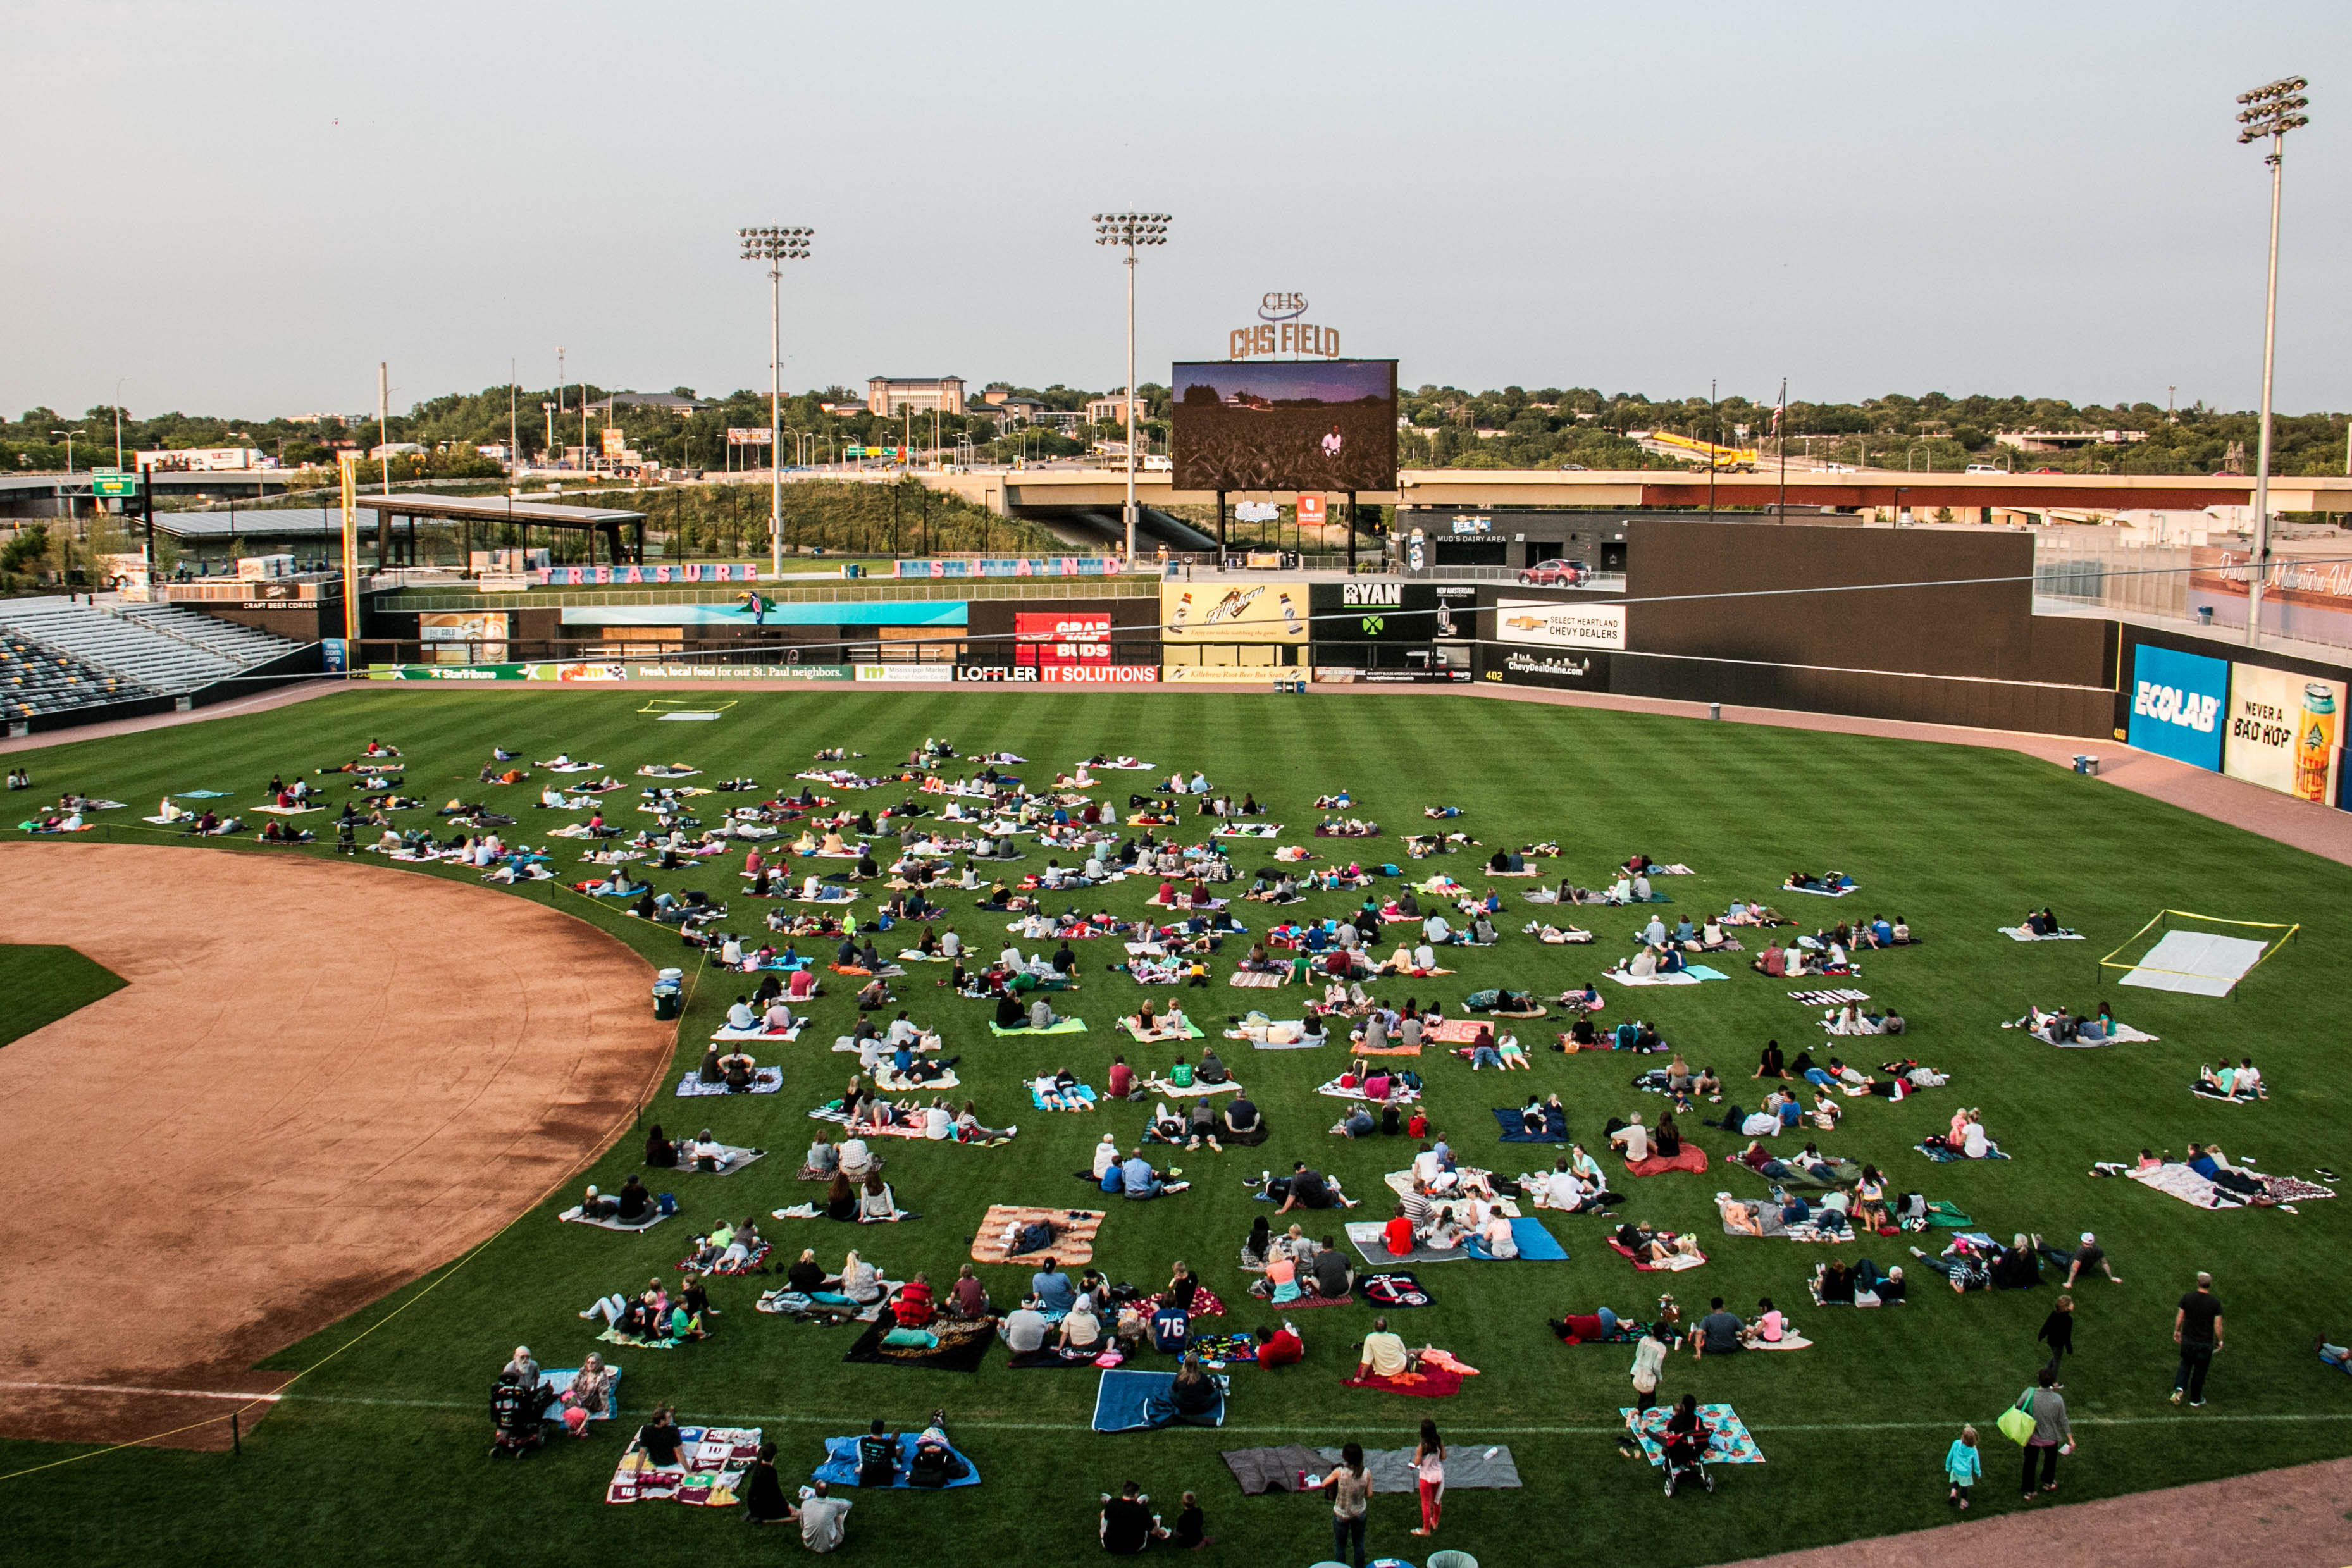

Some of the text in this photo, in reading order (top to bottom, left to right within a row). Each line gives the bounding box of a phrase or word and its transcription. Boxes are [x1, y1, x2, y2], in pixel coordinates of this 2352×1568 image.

[1263, 292, 1304, 309] CHS
[1230, 323, 1339, 359] CHS FIELD
[538, 563, 757, 585] TREASURE
[893, 557, 1120, 578] ISLAND
[1343, 584, 1401, 604] RYAN
[1204, 586, 1265, 624] Killebrew
[1056, 622, 1109, 635] GRAB
[1550, 616, 1618, 627] SELECT HEARTLAND
[1550, 626, 1618, 639] CHEVY DEALERS
[1056, 644, 1108, 657] BUDS
[442, 669, 497, 679] StarTribune
[639, 666, 667, 677] Fresh,
[669, 665, 692, 676] local
[693, 666, 715, 676] food
[717, 667, 732, 676] for
[753, 667, 766, 676] St.
[769, 667, 789, 676] Paul
[791, 667, 842, 679] neighbors.
[957, 666, 1037, 681] LOFFLER
[1044, 667, 1056, 681] IT
[1062, 667, 1155, 682] SOLUTIONS
[1485, 670, 1503, 681] 402
[1509, 661, 1583, 676] ChevyDealOnline.com
[2134, 680, 2217, 733] ECOLAB
[2245, 701, 2283, 722] NEVER A
[2113, 727, 2126, 740] 400
[2234, 717, 2291, 748] BAD HOP
[1159, 1318, 1185, 1338] 76
[621, 1486, 636, 1497] 10
